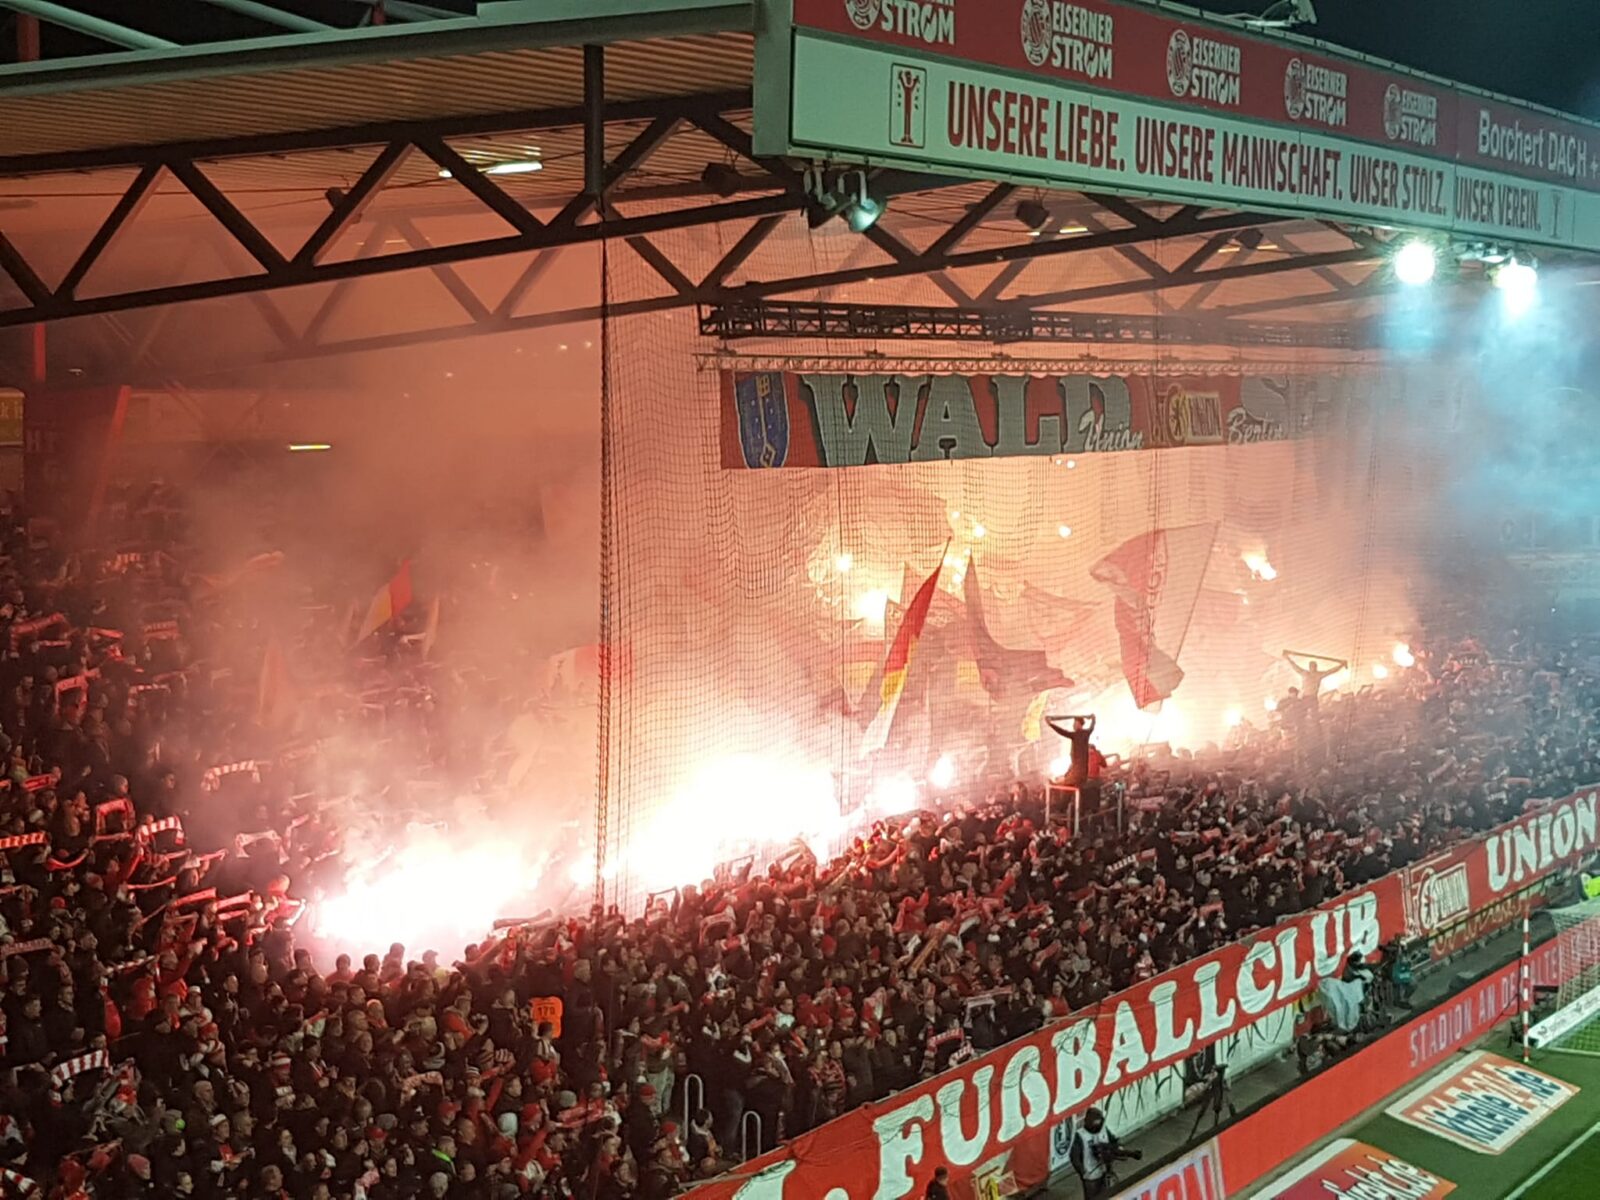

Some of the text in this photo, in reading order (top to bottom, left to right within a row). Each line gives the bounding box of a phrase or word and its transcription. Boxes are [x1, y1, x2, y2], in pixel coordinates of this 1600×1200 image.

[1053, 1, 1113, 44] EISERNER
[1192, 37, 1240, 74] EISERNER
[1306, 63, 1347, 98] EISERNER
[948, 80, 1541, 231] UNSERE LIEBE. UNSERE MANNSCHAFT. UNSER STOLZ. UNSER VEREIN.
[1478, 110, 1544, 168] Borchert
[1548, 131, 1587, 177] DACH
[802, 371, 1133, 467] WALD
[1078, 409, 1144, 450] Union
[1486, 792, 1598, 891] UNION
[1410, 997, 1472, 1067] STADION
[1479, 983, 1495, 1025] AN
[1501, 963, 1528, 1009] DE
